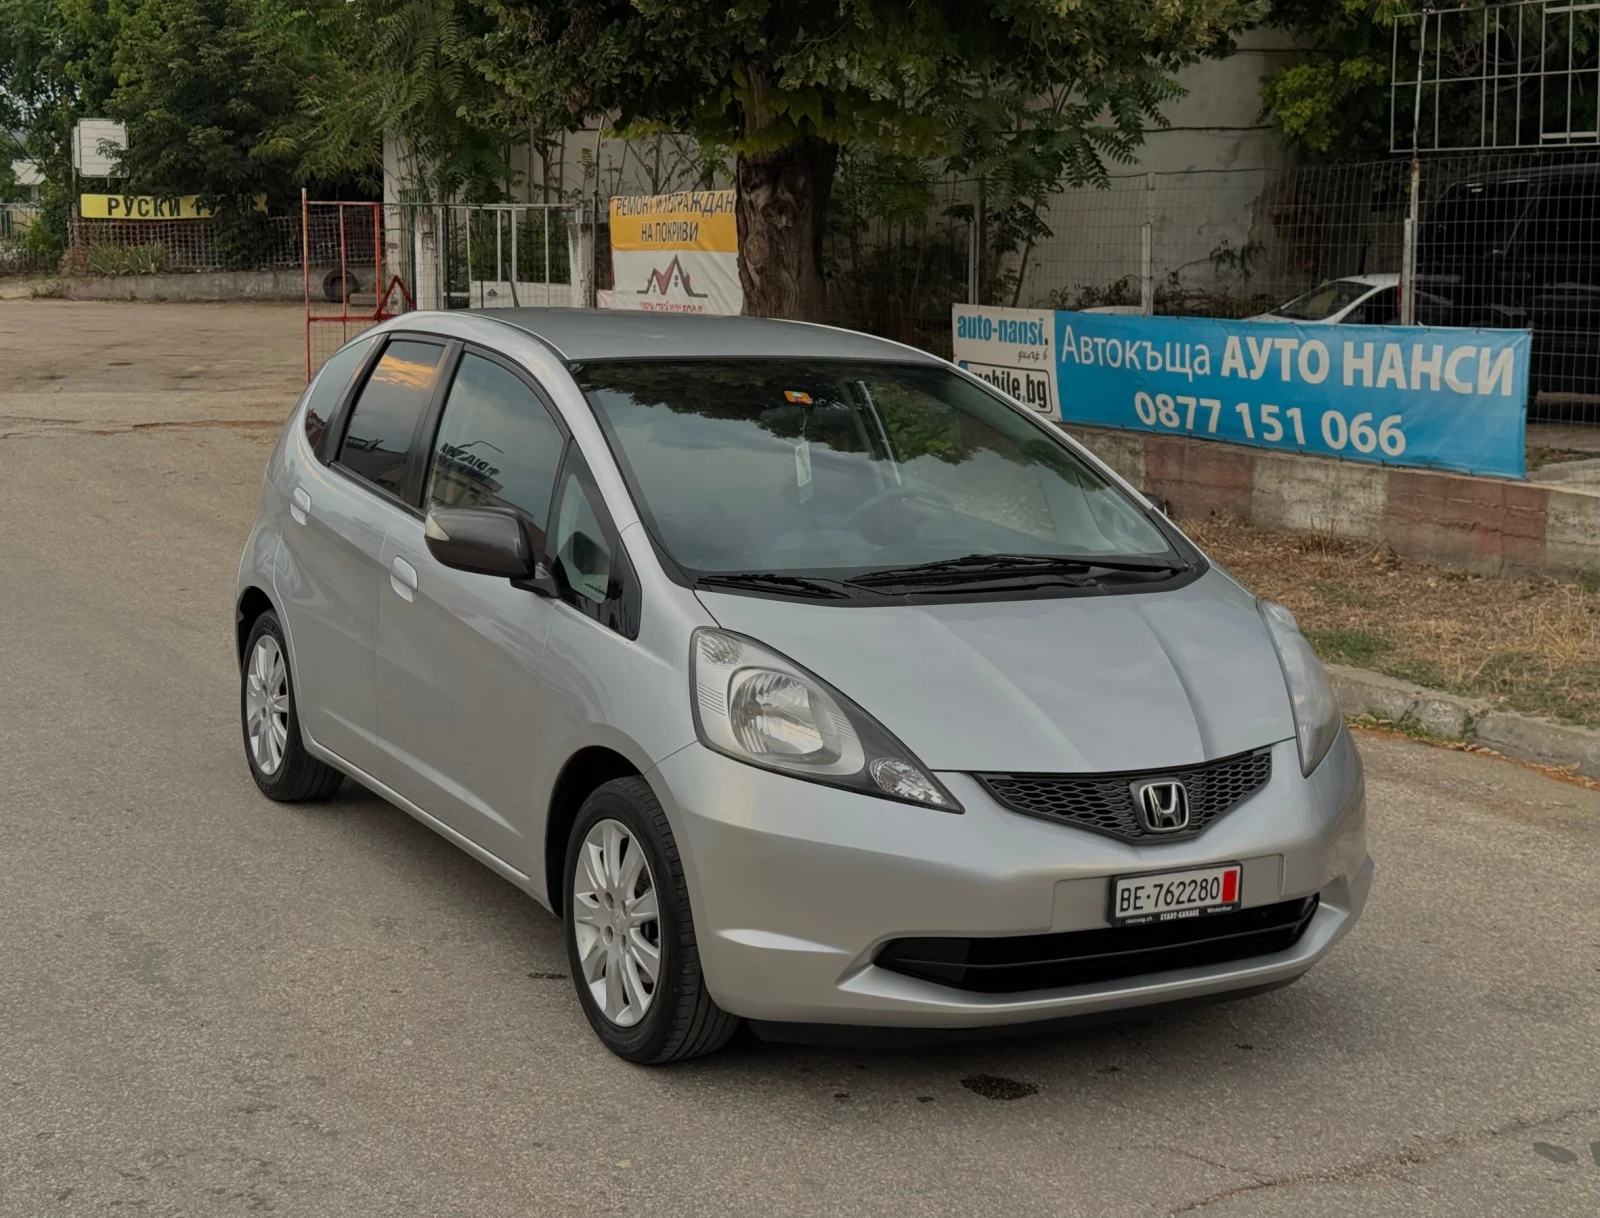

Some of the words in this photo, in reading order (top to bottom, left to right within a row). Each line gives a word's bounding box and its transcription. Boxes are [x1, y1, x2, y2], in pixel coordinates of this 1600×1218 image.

[107, 197, 181, 217] РУСКИ
[616, 196, 653, 216] РЕМОНТ
[641, 223, 653, 242] НА
[655, 221, 699, 242] ПОКРИВИ
[1061, 324, 1211, 383] Автокъща
[1220, 335, 1330, 385] АУТО
[1343, 341, 1515, 396] НАНСИ
[973, 370, 1048, 409] bile.bg
[1134, 391, 1222, 433] 0877
[1235, 402, 1306, 445] 151
[1321, 410, 1407, 456] 066
